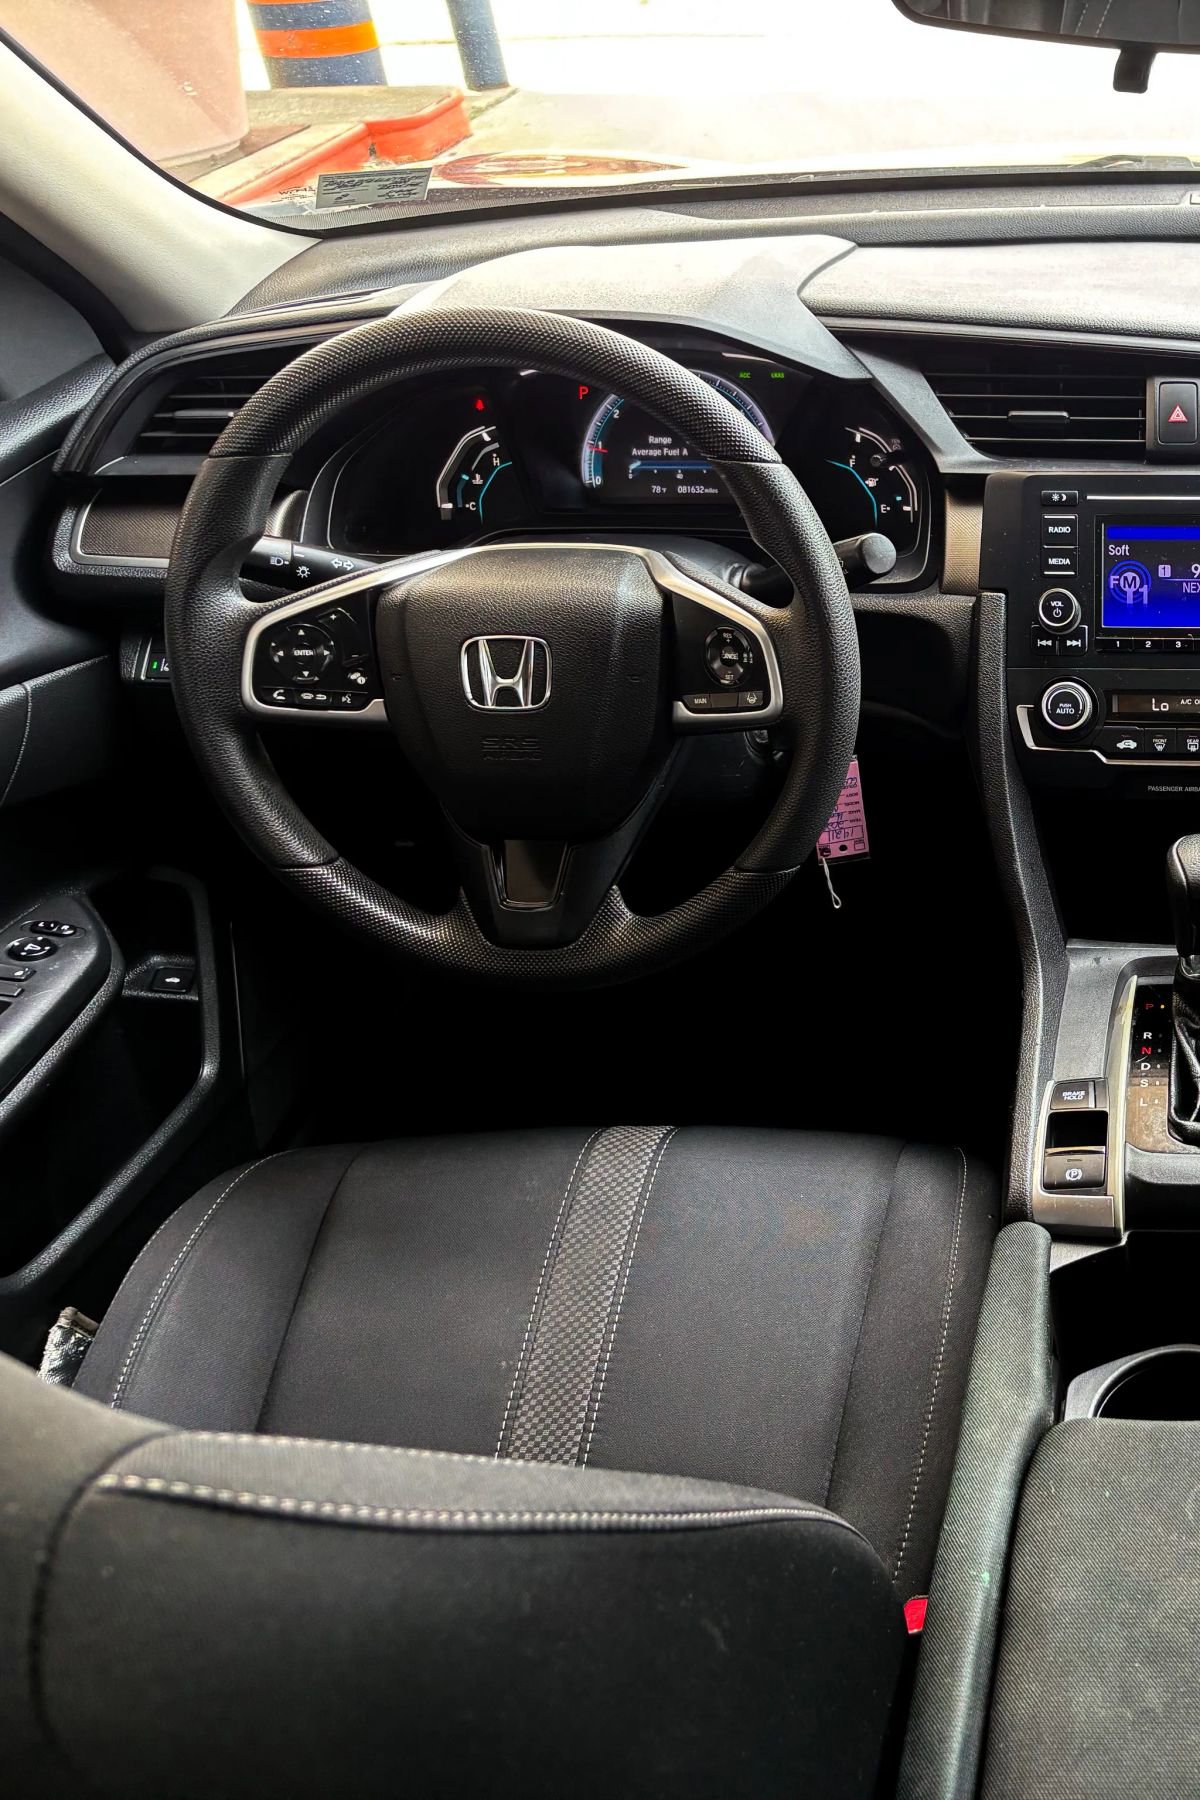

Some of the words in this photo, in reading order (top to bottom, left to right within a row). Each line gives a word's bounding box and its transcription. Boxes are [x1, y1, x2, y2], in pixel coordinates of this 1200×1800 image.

[578, 384, 590, 400] P
[613, 409, 620, 419] 2
[648, 436, 672, 445] Range
[632, 448, 662, 456] Average
[663, 448, 680, 456] Fuel
[493, 457, 500, 466] H
[849, 459, 856, 467] F
[677, 485, 704, 493] 081632
[469, 502, 477, 510] C
[880, 504, 887, 513] E
[1108, 544, 1130, 556] Soft
[1141, 1046, 1152, 1055] N
[1140, 1079, 1149, 1087] S
[1139, 1097, 1148, 1106] L
